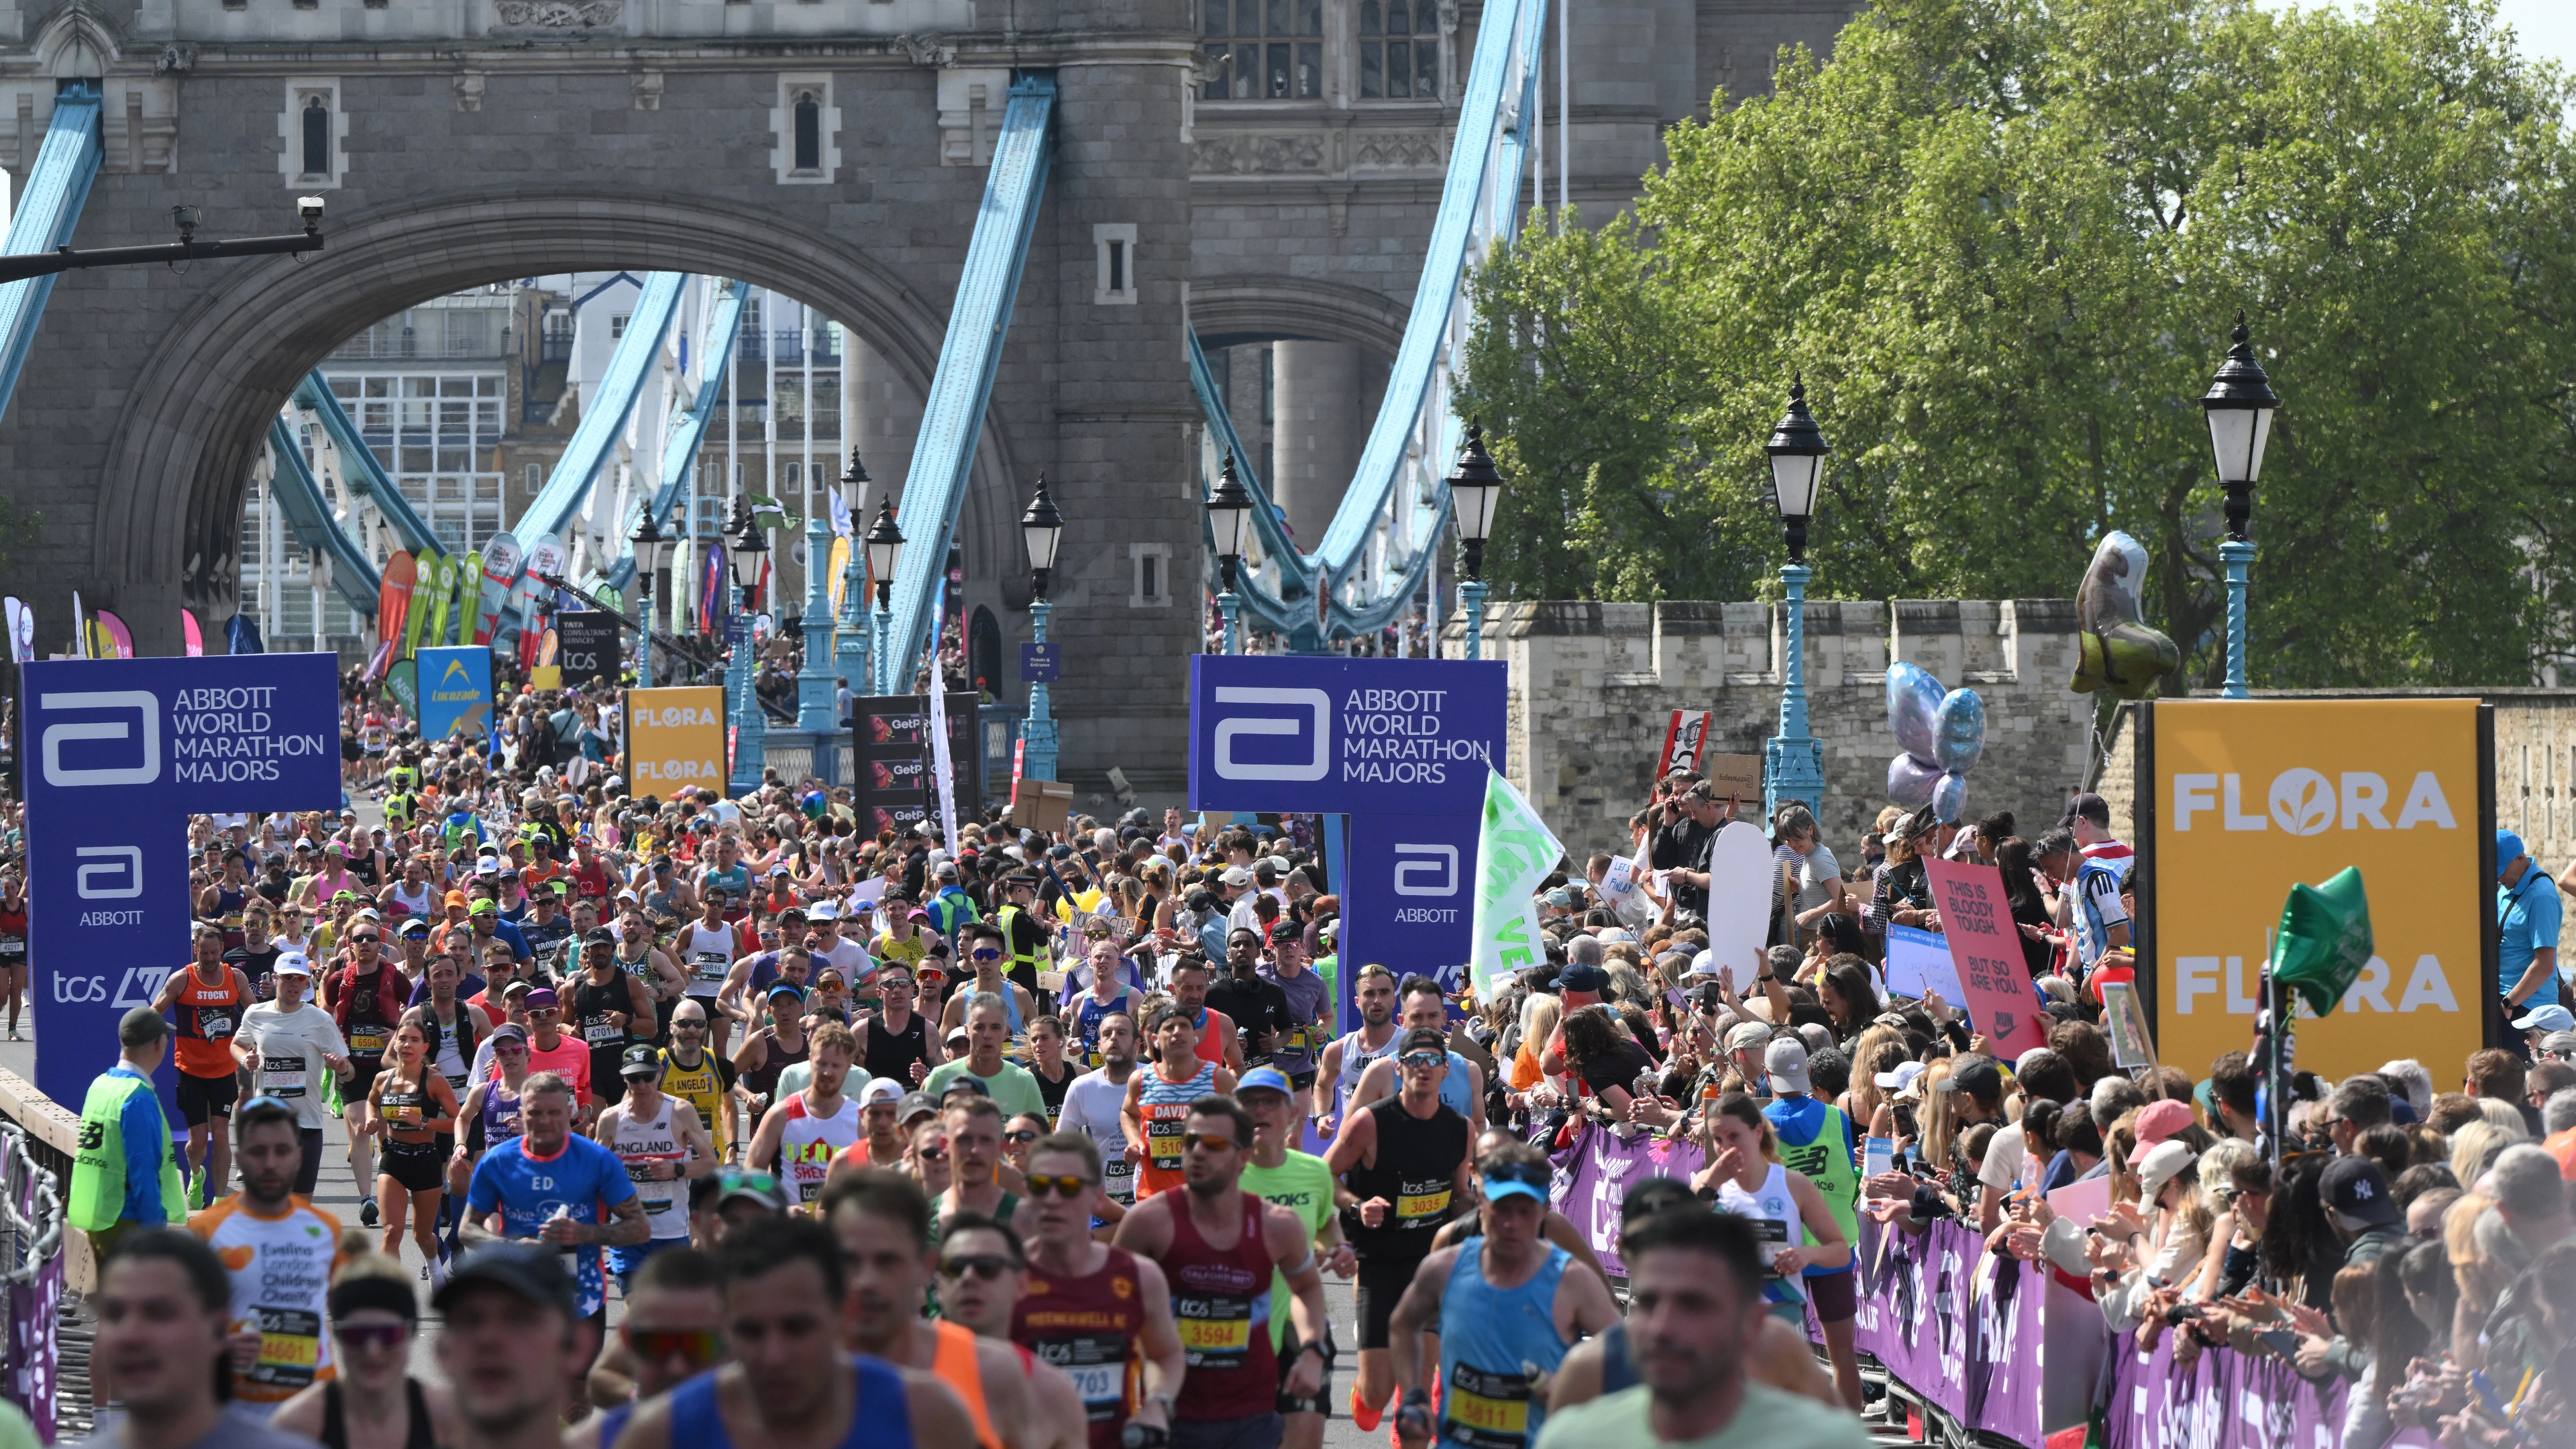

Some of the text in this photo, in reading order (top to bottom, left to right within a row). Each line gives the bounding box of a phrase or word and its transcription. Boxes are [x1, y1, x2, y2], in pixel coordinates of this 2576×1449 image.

[563, 629, 612, 637] CONSULTANCY
[563, 648, 598, 671] tcs
[173, 686, 276, 711] ABBOTT
[432, 688, 480, 702] Lucozade
[1344, 689, 1447, 712] ABBOTT
[173, 712, 271, 735] WORLD
[634, 706, 716, 728] FLORA
[1344, 714, 1440, 736] WORLD
[174, 734, 324, 759] MARATHON
[1344, 739, 1490, 760] MARATHON
[175, 759, 280, 783] MAJORS
[635, 759, 718, 780] FLORA
[1344, 763, 1446, 784] MAJORS
[2174, 767, 2457, 837] FLORA
[1608, 877, 1633, 894] FINLAY
[1946, 879, 1987, 900] THIS IS
[1395, 908, 1458, 923] ABBOTT
[1948, 896, 1993, 918] BLOODY
[79, 910, 144, 926] ABBOTT
[1954, 914, 2000, 936] TOUGH.
[1911, 932, 1935, 944] NEVER
[1968, 955, 2010, 977] BUT SO
[53, 970, 106, 1003] tcs
[1970, 973, 1992, 991] ARE
[1991, 976, 2022, 995] YOU.
[2176, 955, 2459, 1020] FLRA
[197, 990, 229, 1000] STOCKY
[585, 1016, 599, 1026] tcs
[1995, 1010, 2015, 1028] RUN
[352, 1026, 364, 1034] tcs
[358, 1038, 377, 1047] 6594
[266, 1059, 280, 1070] tcs
[270, 1075, 300, 1085] 38514
[676, 1078, 706, 1091] ANGELO
[496, 1111, 519, 1124] AMY
[1155, 1106, 1191, 1118] DAVID
[485, 1124, 510, 1133] Leonar
[1151, 1123, 1171, 1134] tcs
[616, 1140, 673, 1154] ENGLAND
[74, 1153, 109, 1170] alance
[1109, 1163, 1126, 1175] tcs
[794, 1166, 826, 1179] SHEL
[531, 1176, 554, 1191] ED
[1402, 1181, 1424, 1194] tcs
[1411, 1198, 1440, 1214] 3035
[1180, 1298, 1209, 1318] tcs
[1191, 1326, 1234, 1345] 3594
[1037, 1340, 1071, 1364] tcs
